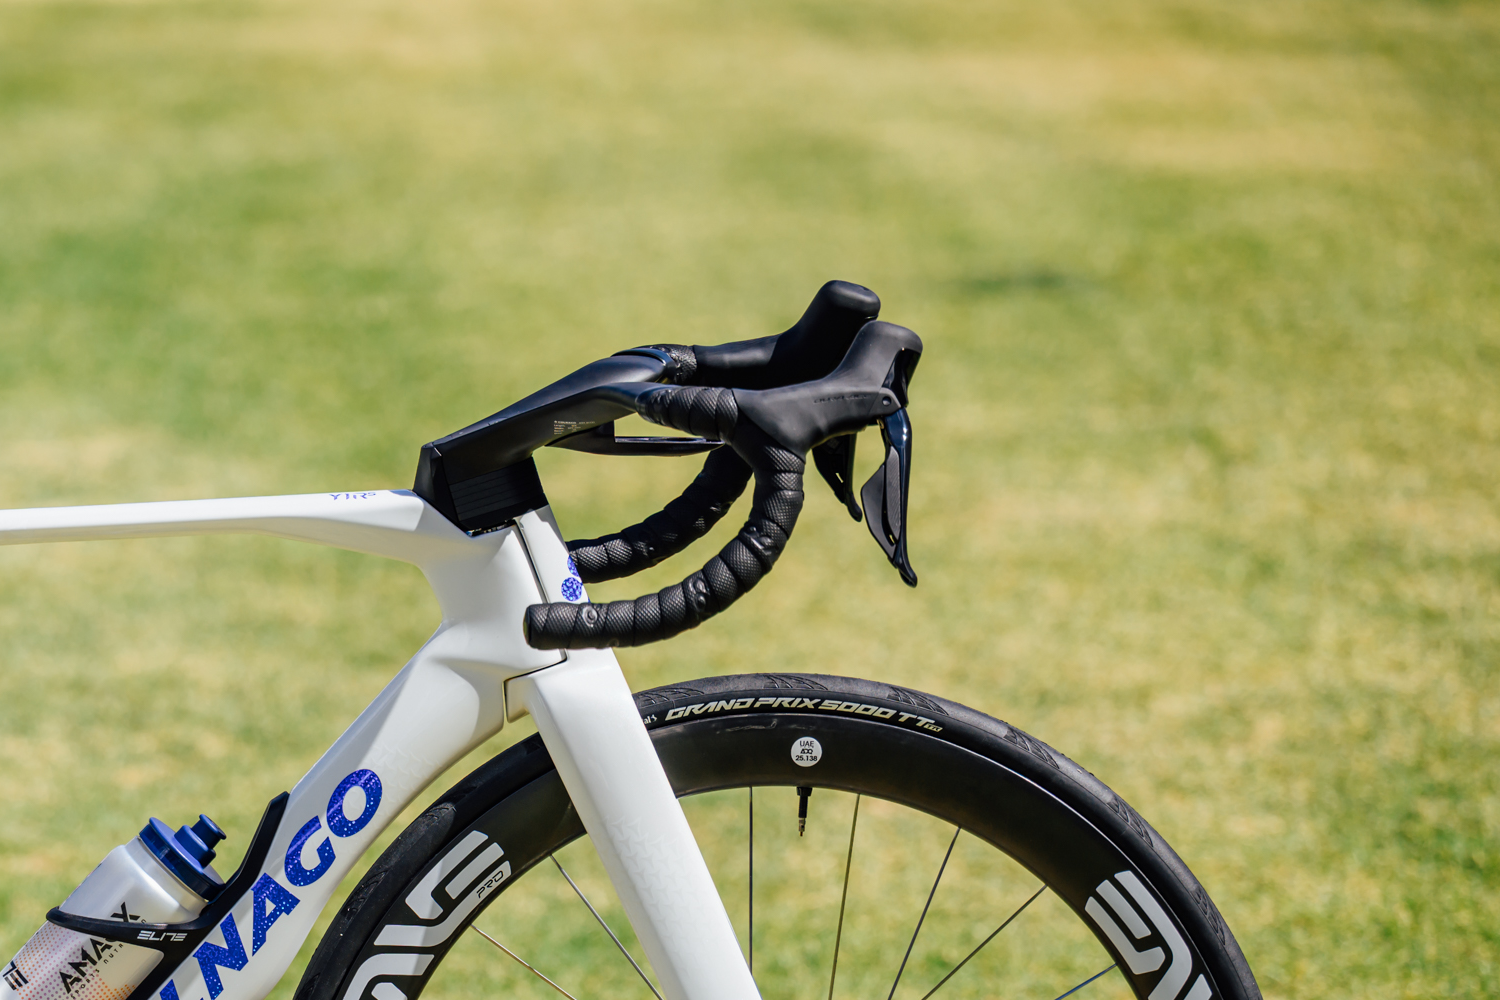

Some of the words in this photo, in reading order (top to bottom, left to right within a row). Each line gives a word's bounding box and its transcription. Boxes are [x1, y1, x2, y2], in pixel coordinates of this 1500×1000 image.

[665, 697, 753, 721] GRAND
[753, 696, 821, 709] PRIX
[820, 699, 894, 719] 5000
[476, 870, 504, 899] PRO
[59, 901, 140, 994] AMAX
[136, 930, 188, 942] ELITE
